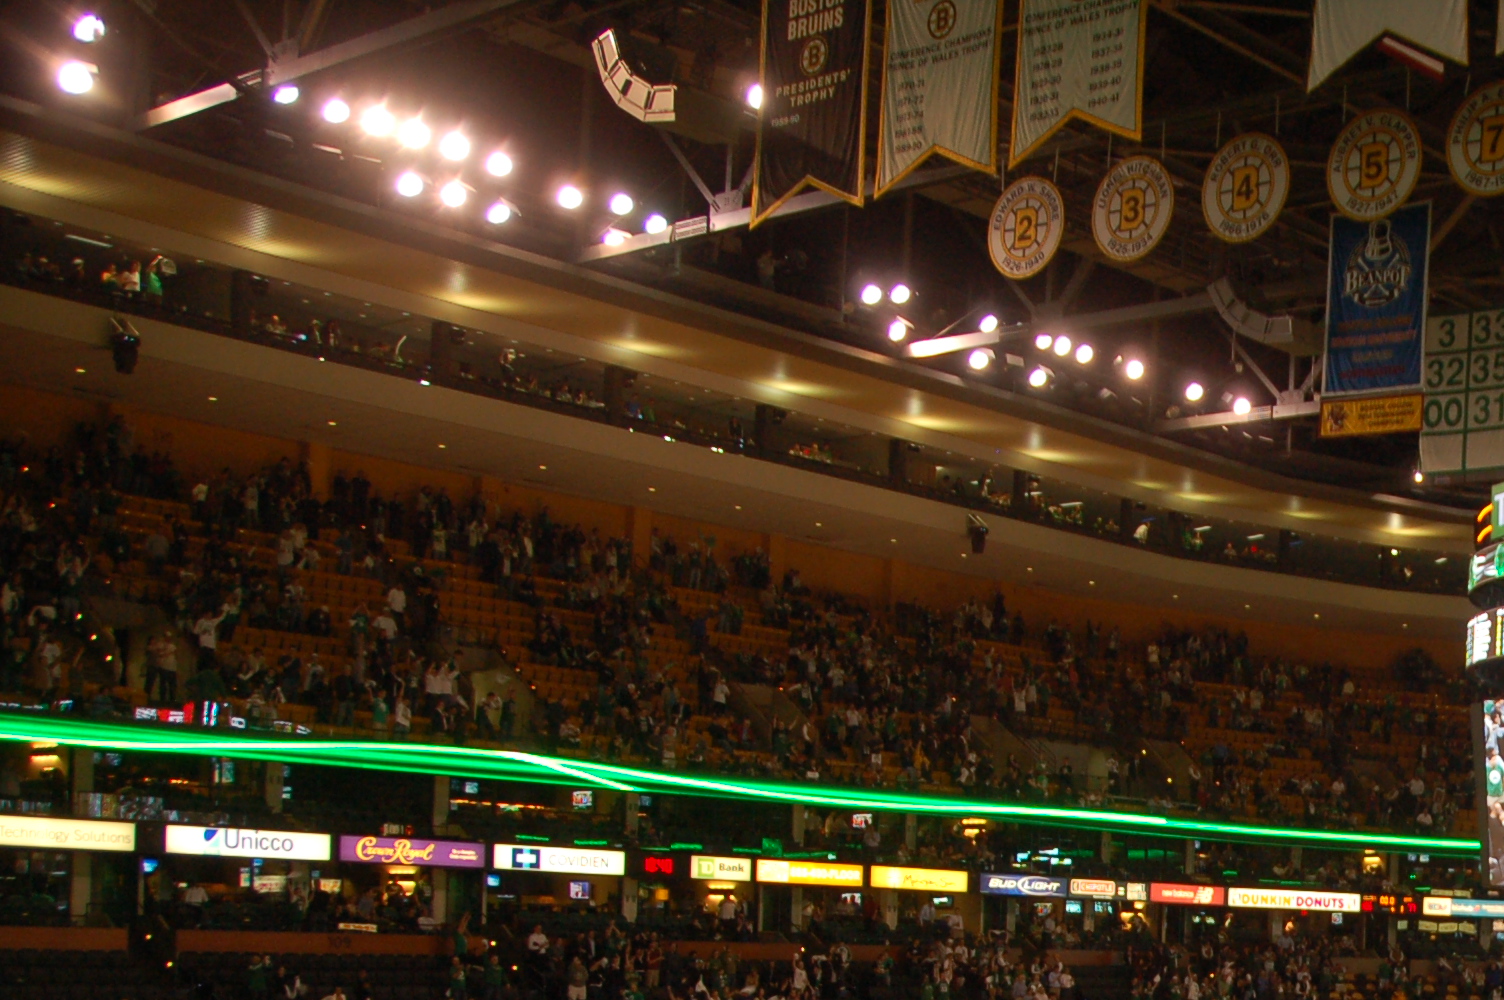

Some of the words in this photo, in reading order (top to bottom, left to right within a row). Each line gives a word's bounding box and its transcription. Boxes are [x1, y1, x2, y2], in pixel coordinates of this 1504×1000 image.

[787, 6, 844, 40] BRUINS
[775, 68, 851, 98] PRESIDENTS'
[790, 85, 836, 108] TROPHY
[1333, 122, 1365, 173] AUBREY
[1379, 116, 1417, 161] CLAPPER
[1487, 124, 1502, 154] 7
[1210, 140, 1248, 183] ROBERT
[1262, 142, 1283, 169] ORR
[1365, 151, 1382, 180] 5
[1236, 174, 1255, 198] 4
[994, 184, 1025, 232] EDWARD
[1123, 198, 1141, 224] 3
[1016, 215, 1032, 241] 2
[1345, 265, 1411, 294] BEANPOT
[1438, 319, 1456, 348] 3
[1427, 357, 1464, 388] 32
[1423, 398, 1463, 428] 00
[1473, 393, 1504, 424] 31
[74, 829, 133, 845] Solutions
[223, 826, 295, 853] Unicco
[356, 837, 398, 862] Crown
[388, 838, 436, 865] Royal
[548, 854, 610, 869] COVIDIEN
[698, 859, 714, 877] TD
[718, 861, 745, 874] Bank
[988, 876, 1017, 889] BUD
[1023, 879, 1061, 893] LIGHT
[1295, 896, 1345, 910] DONUTS
